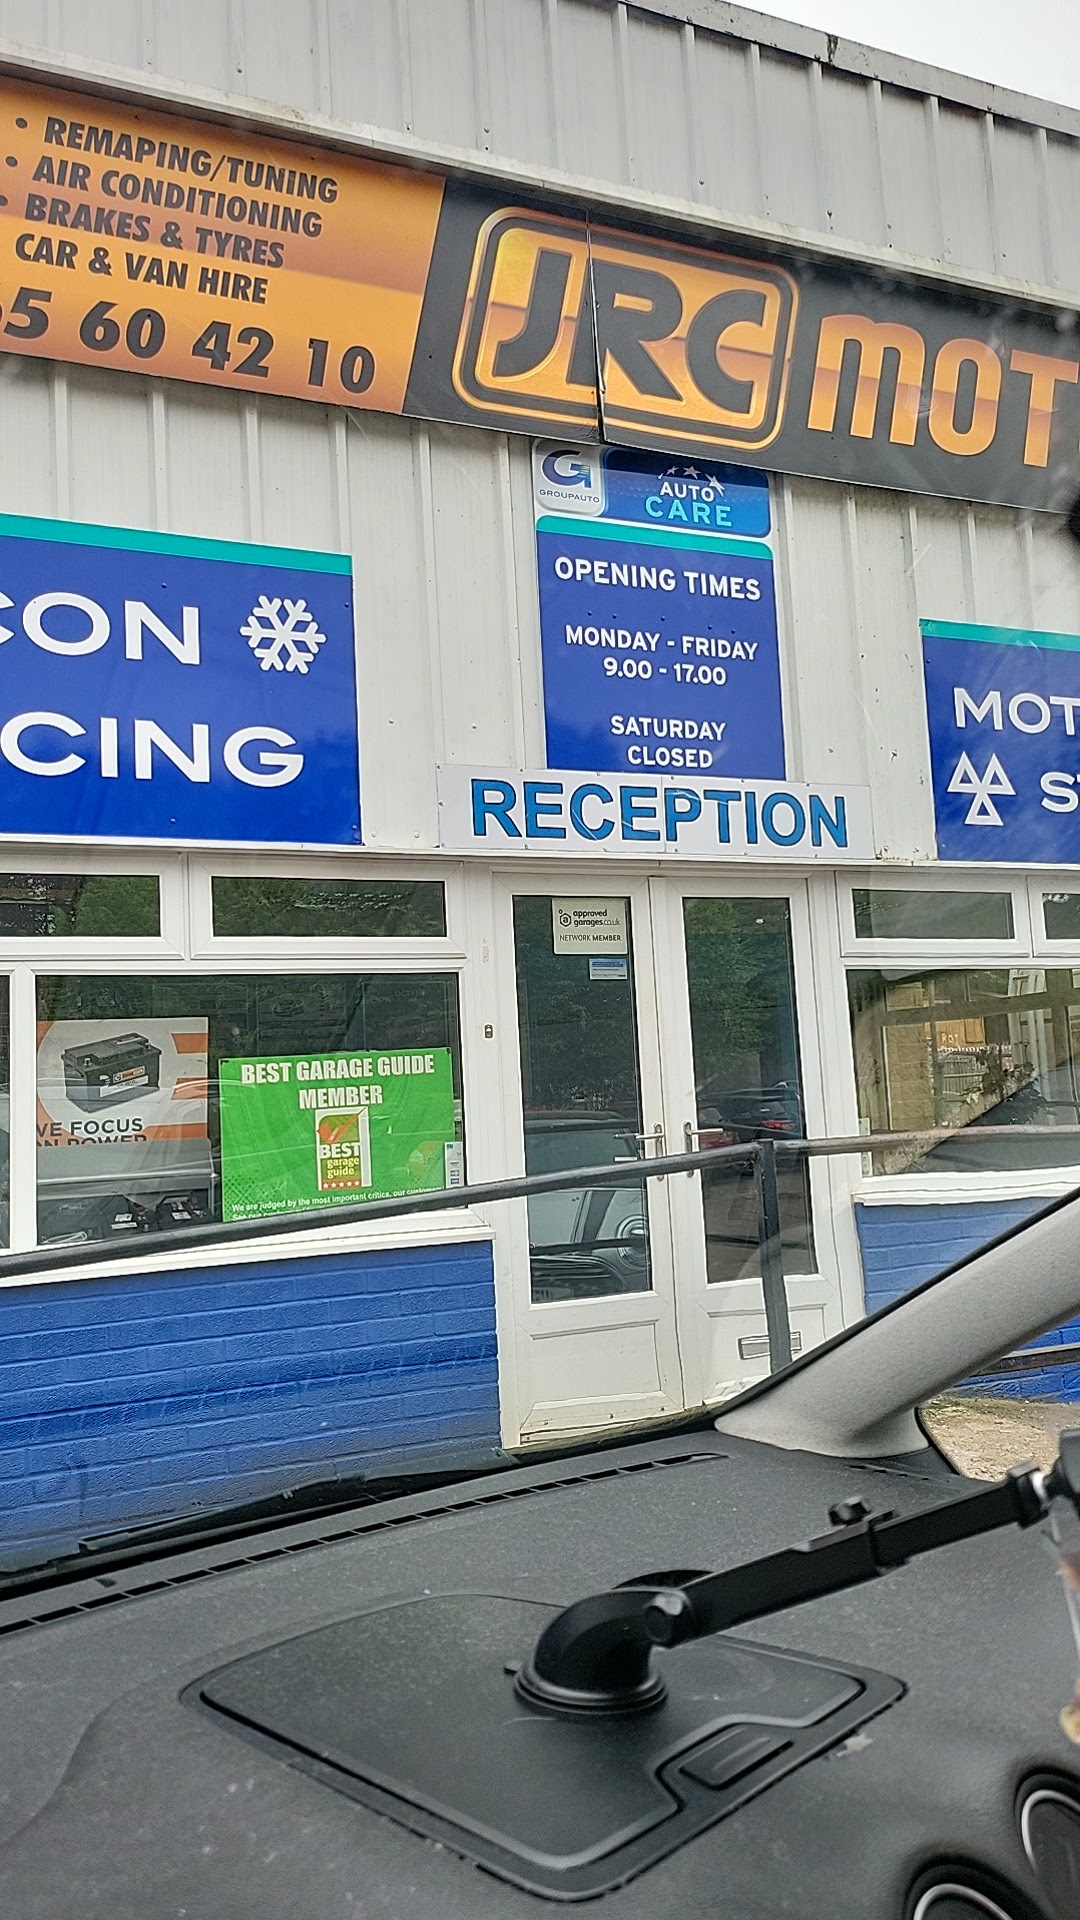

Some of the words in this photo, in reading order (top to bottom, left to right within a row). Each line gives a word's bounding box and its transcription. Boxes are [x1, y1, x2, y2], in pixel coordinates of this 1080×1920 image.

[44, 116, 338, 203] REMAPING/TUNING
[33, 156, 91, 191] AIR
[100, 170, 323, 238] CONDITIONING
[24, 193, 151, 243] BRAKES
[160, 221, 183, 250] &
[195, 227, 284, 269] TYRES
[15, 233, 79, 270] CAR
[88, 247, 113, 277] &
[125, 252, 188, 290] VAN
[199, 267, 268, 304] HIRE
[0, 286, 53, 339] 5
[79, 301, 165, 359] 60
[191, 321, 274, 378] 42
[307, 338, 375, 394] 10
[490, 248, 769, 415] JRC
[539, 489, 600, 503] GROUPAUTO
[659, 481, 715, 502] AUTO
[645, 496, 732, 527] CARE
[554, 556, 676, 591] OPENING
[683, 571, 761, 601] TIMES
[0, 591, 200, 665] ON
[565, 625, 660, 651] MONDAY
[682, 636, 758, 661] FRIDAY
[603, 657, 652, 679] 9.00
[673, 663, 727, 685] 17.00
[610, 715, 726, 741] SATURDAY
[0, 711, 304, 788] CING
[627, 746, 713, 768] CLOSED
[1040, 771, 1080, 813] S
[470, 778, 849, 848] RECEPTION
[573, 909, 607, 918] approved
[241, 1062, 291, 1084] BEST
[296, 1058, 373, 1080] GARAGE
[378, 1054, 434, 1076] GUIDE
[299, 1085, 383, 1109] MEMBER
[70, 1117, 143, 1136] FOCUS
[320, 1142, 360, 1159] BEST
[327, 1157, 360, 1169] garage
[327, 1166, 355, 1179] guide
[232, 1204, 245, 1212] We
[260, 1200, 286, 1211] judged
[287, 1199, 297, 1209] by
[298, 1198, 311, 1206] the
[311, 1196, 331, 1205] most
[332, 1192, 366, 1203] important
